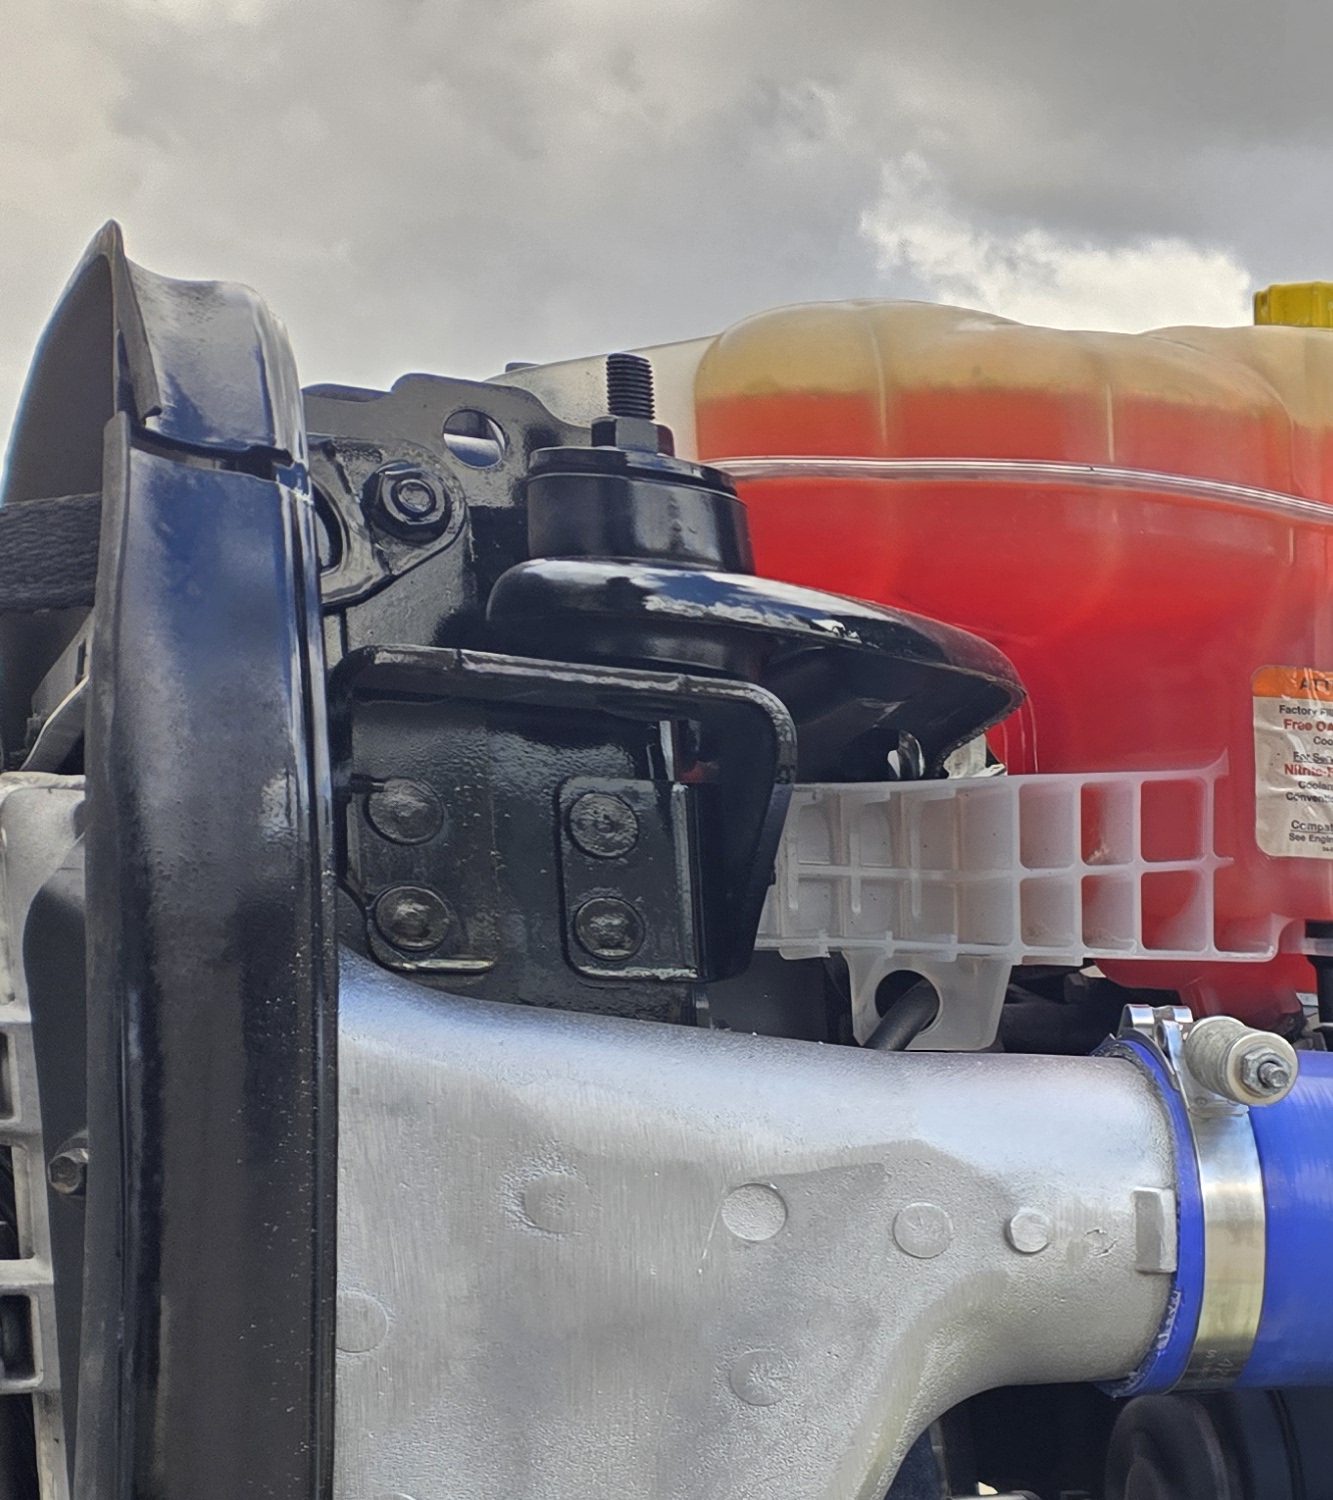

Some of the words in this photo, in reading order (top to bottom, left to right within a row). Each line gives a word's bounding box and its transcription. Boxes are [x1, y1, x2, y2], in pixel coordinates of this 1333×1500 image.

[1279, 705, 1317, 718] Factory
[1284, 718, 1313, 731] Free
[1293, 751, 1310, 763] For
[1289, 833, 1307, 842] See
